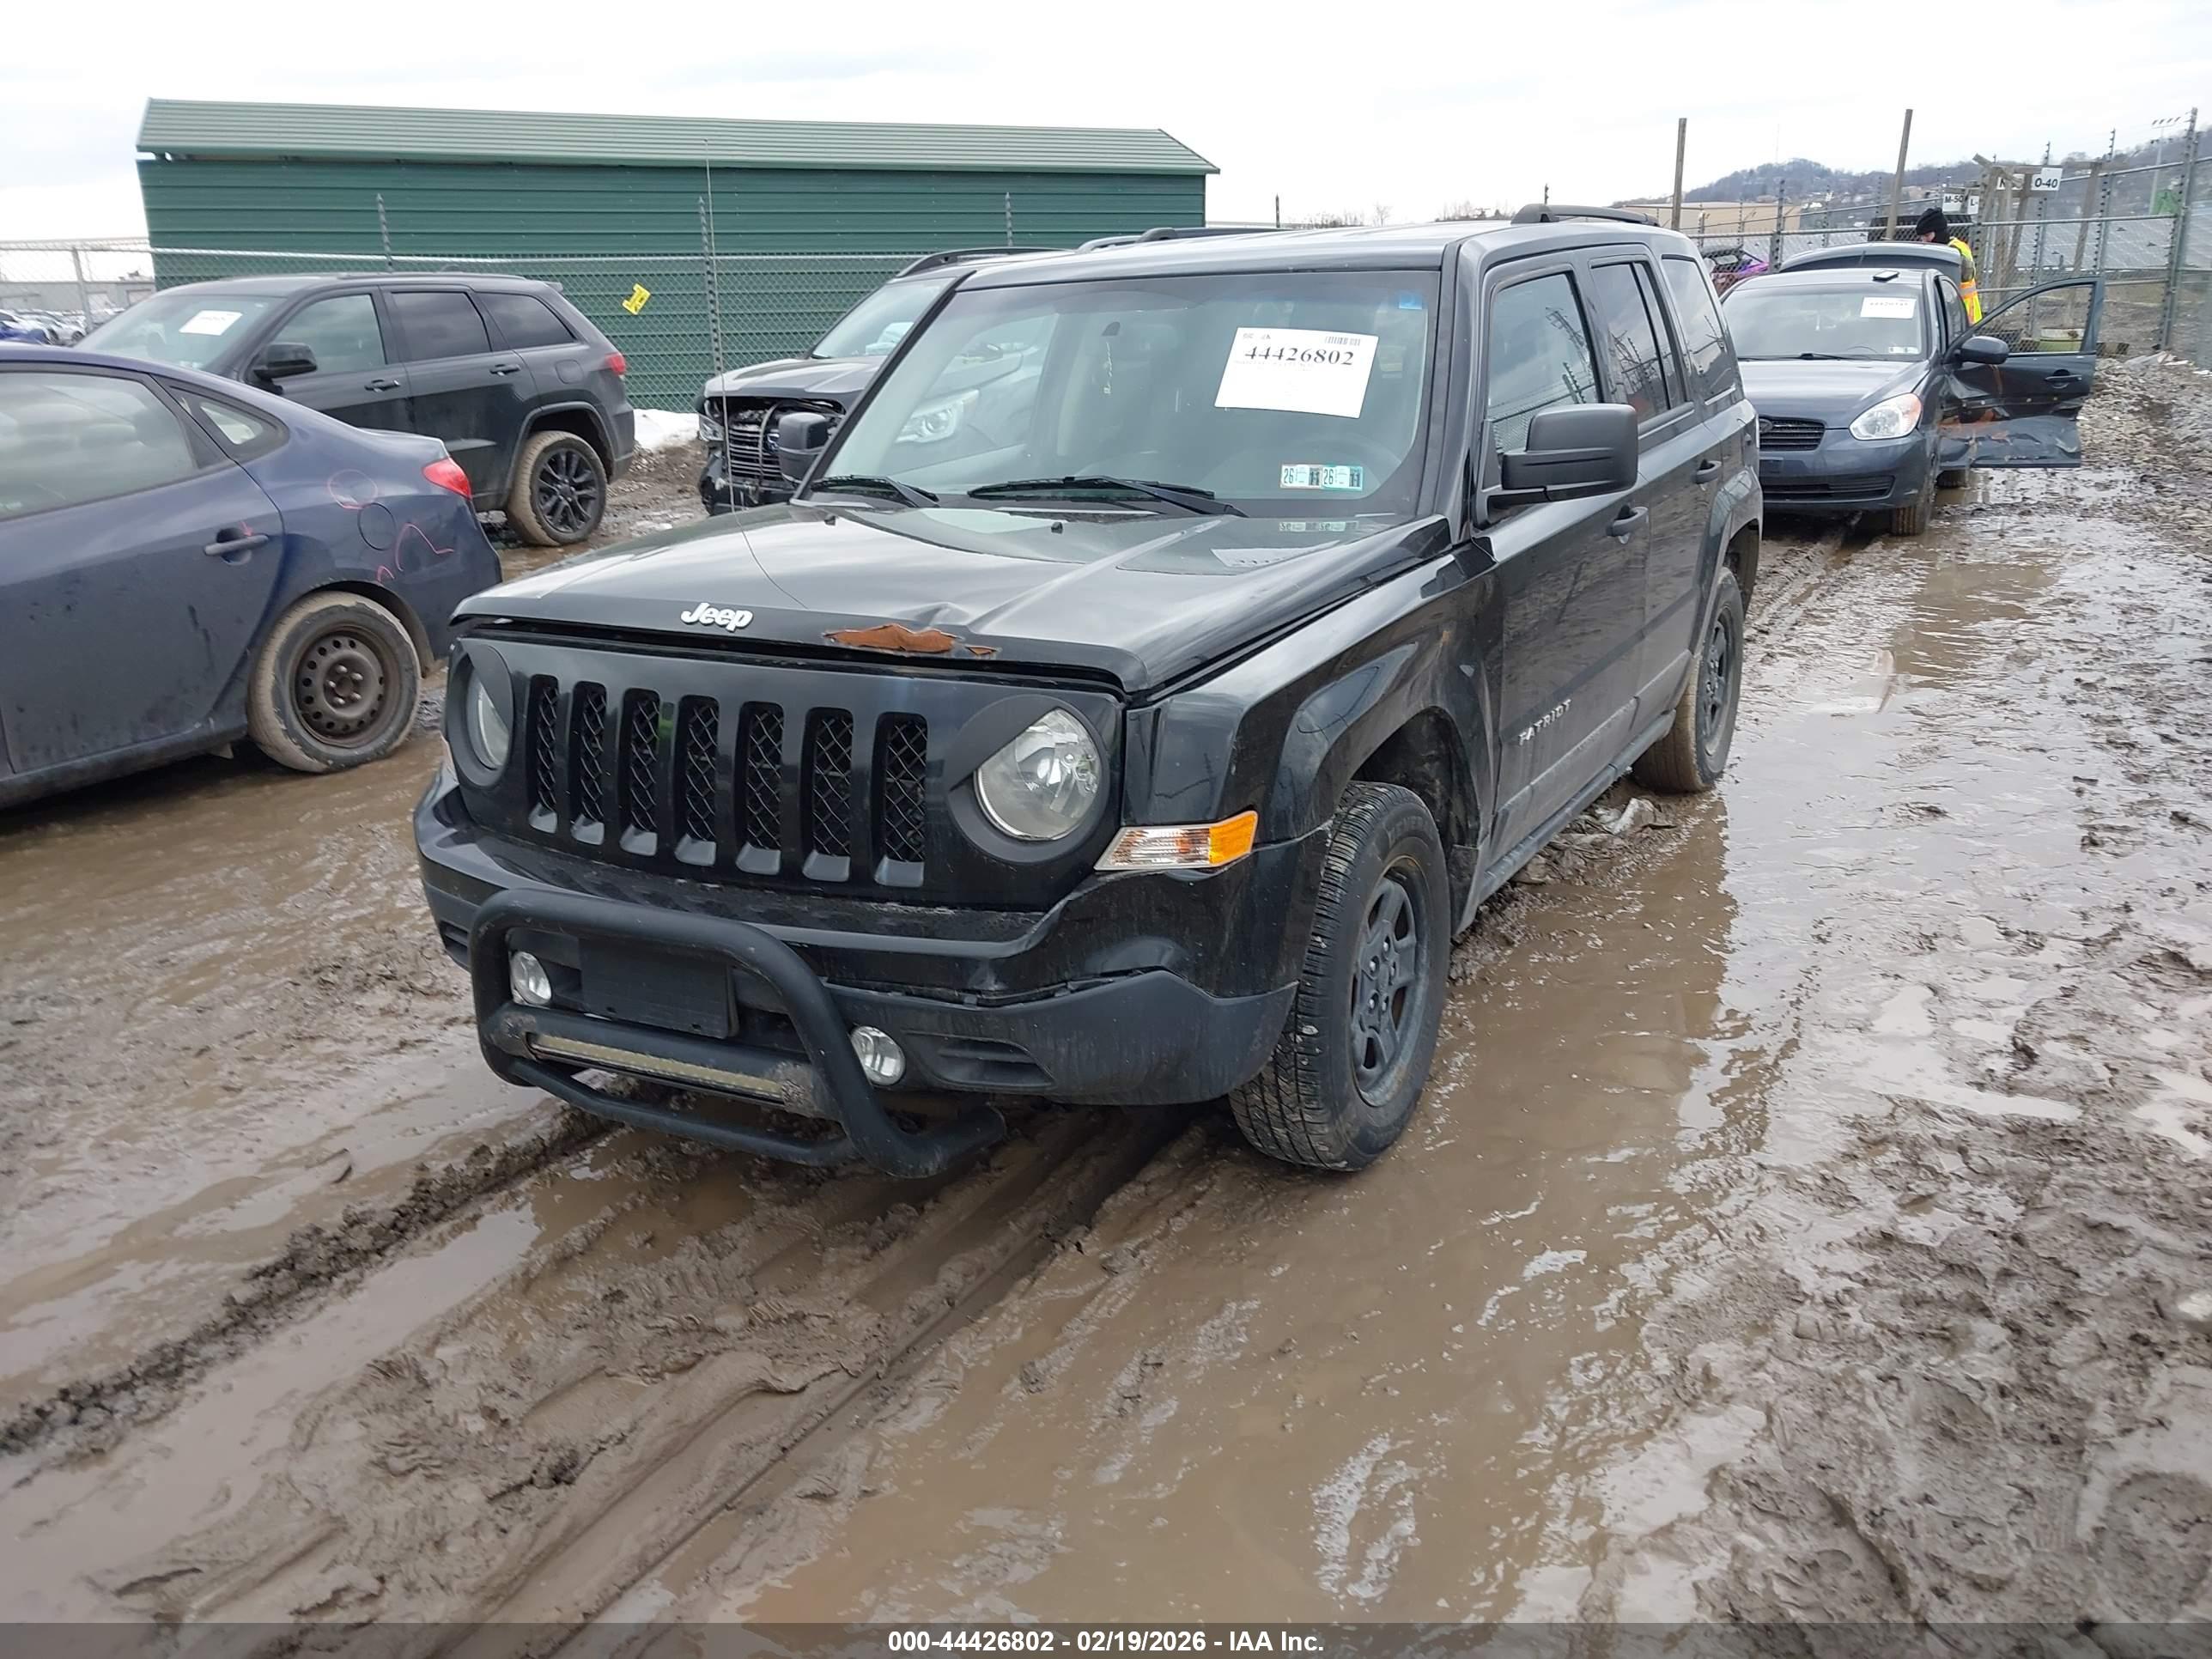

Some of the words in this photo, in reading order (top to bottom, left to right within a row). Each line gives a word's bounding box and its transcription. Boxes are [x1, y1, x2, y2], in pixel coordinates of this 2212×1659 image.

[2034, 178, 2058, 188] O-40
[1945, 195, 1964, 204] M-50
[1244, 346, 1354, 366] 44426802
[1284, 468, 1294, 484] 26
[1323, 468, 1334, 484] 26
[680, 602, 753, 632] Jeep
[1518, 698, 1571, 746] PATRIOT
